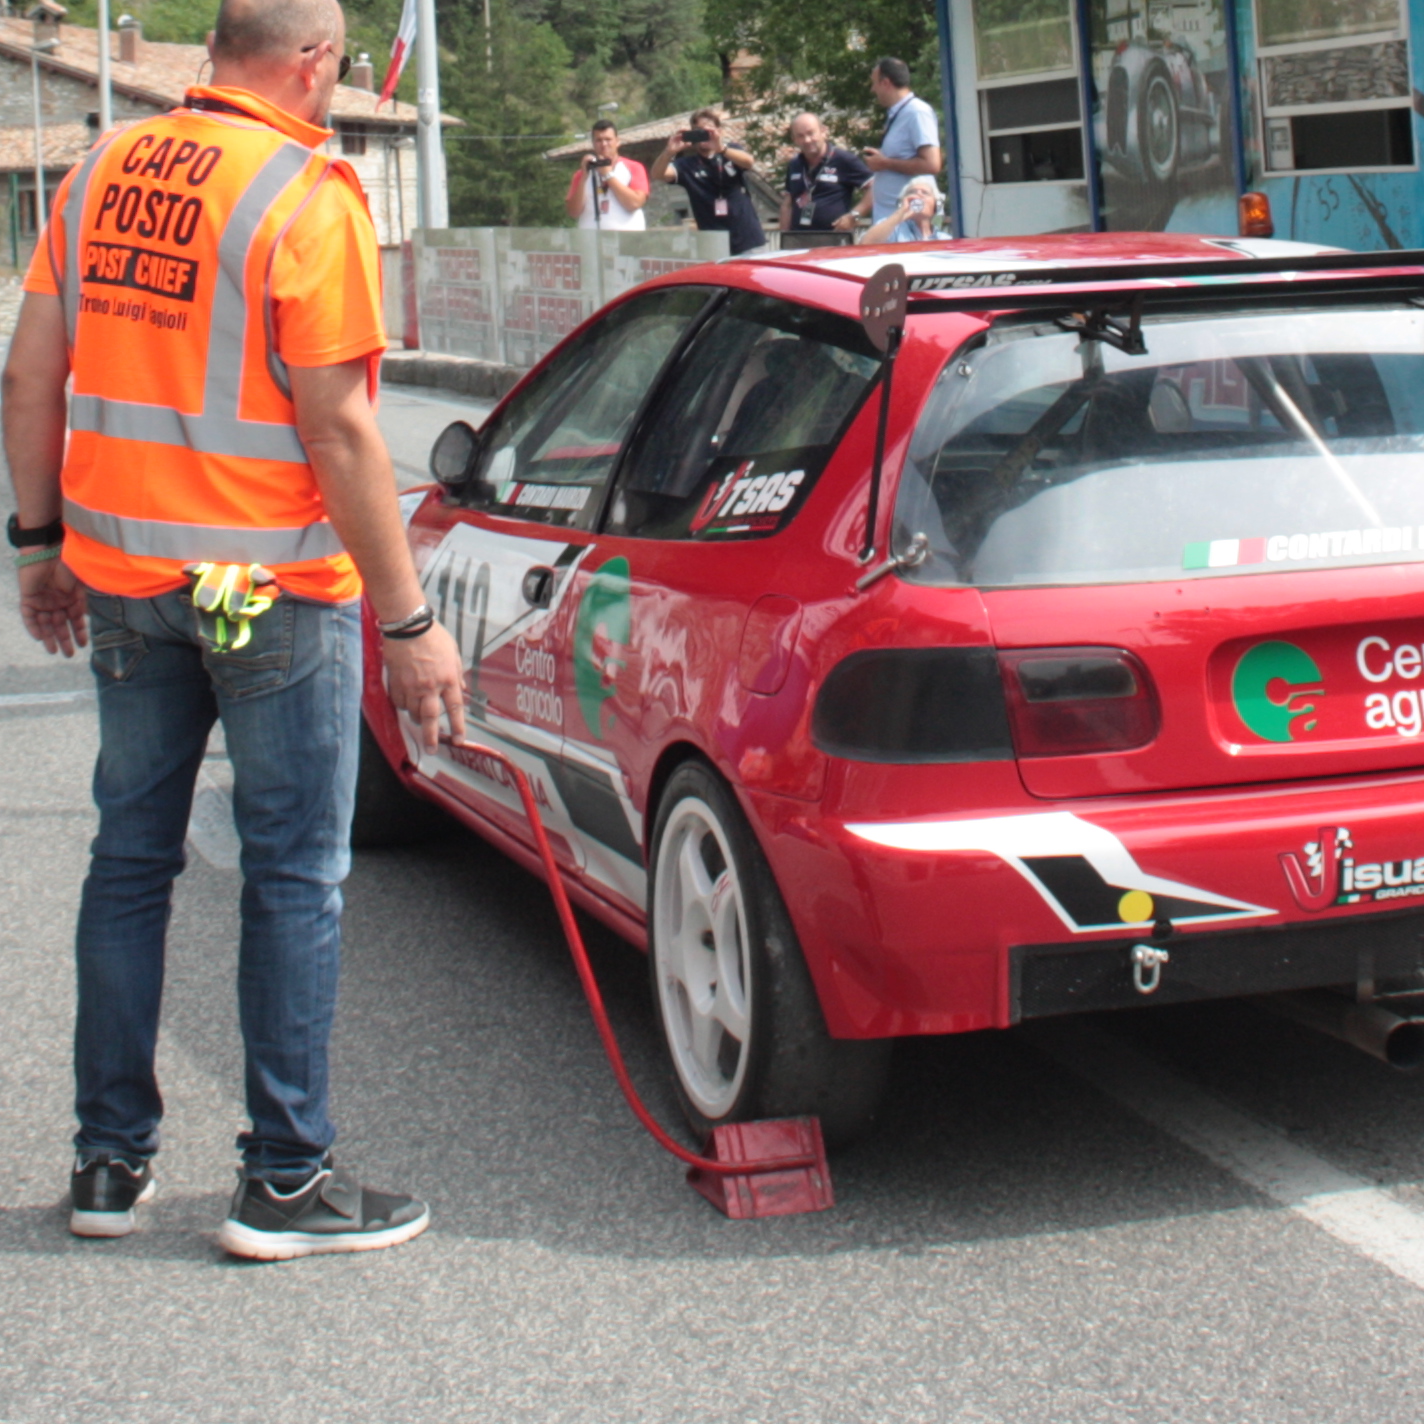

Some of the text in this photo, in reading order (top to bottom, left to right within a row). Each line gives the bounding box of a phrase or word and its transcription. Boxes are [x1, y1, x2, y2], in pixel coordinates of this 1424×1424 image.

[122, 134, 223, 187] CAPO
[94, 183, 203, 246] POSTO
[85, 245, 192, 294] POST CHIEF
[515, 635, 556, 684] Centro
[516, 680, 563, 726] agricolo
